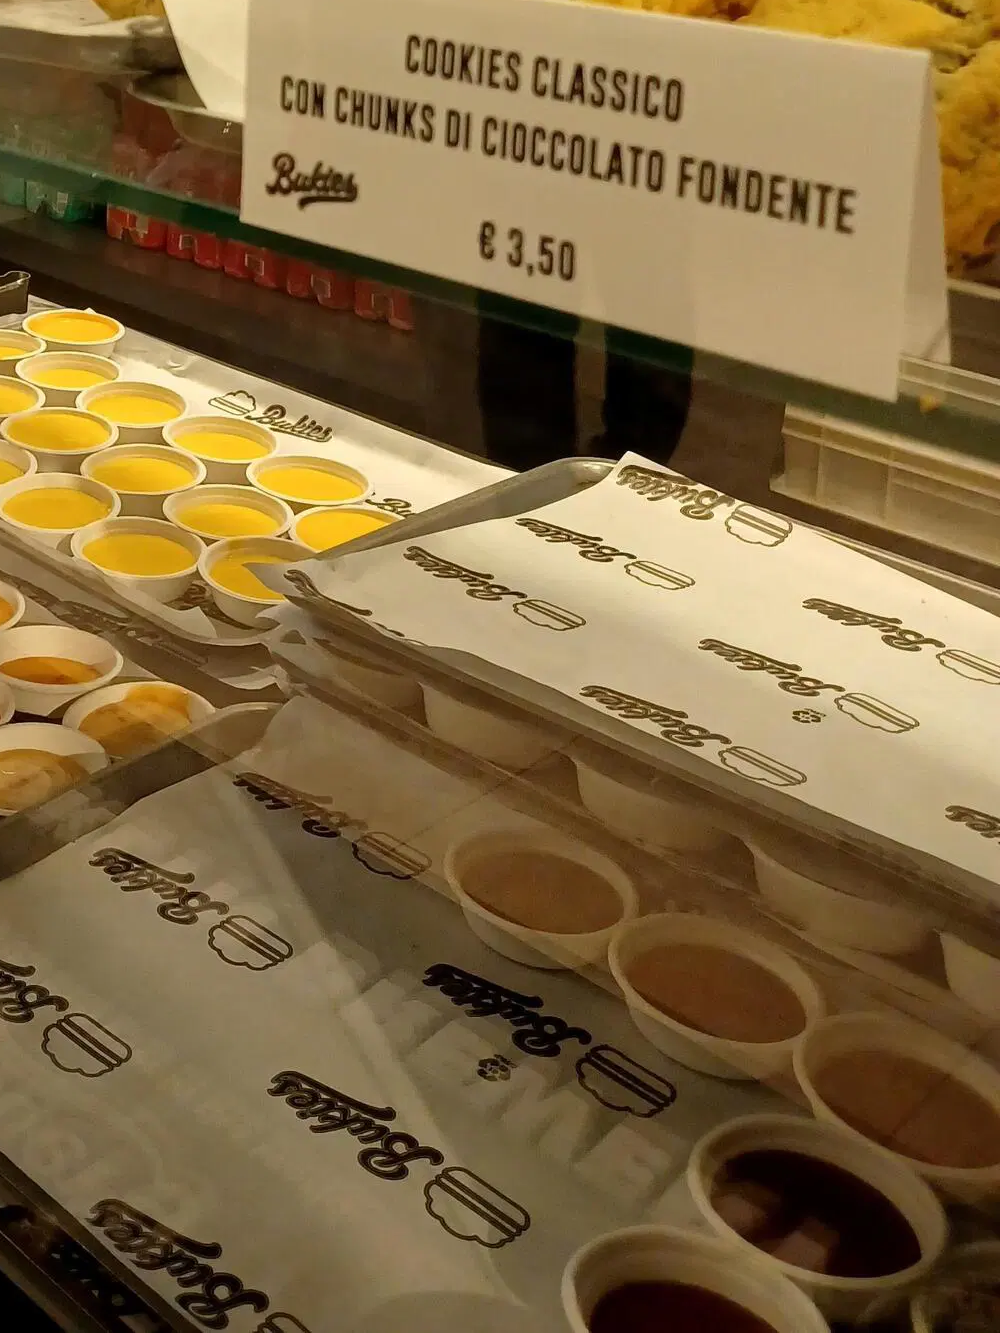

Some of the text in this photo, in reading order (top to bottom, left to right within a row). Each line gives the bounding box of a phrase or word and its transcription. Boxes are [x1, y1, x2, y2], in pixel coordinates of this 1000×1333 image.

[404, 33, 686, 123] COOKIES CLASSICO
[265, 151, 359, 210] Bukies
[280, 74, 858, 235] CON CHUNKS DI CIOCCOLATO FONDENTE
[478, 220, 577, 283] € 3,50
[244, 404, 333, 443] Bukies
[617, 464, 735, 521] Bukies
[515, 517, 638, 563] Bukies
[403, 545, 528, 602] Bukies
[801, 597, 946, 652] Bukies
[698, 638, 846, 697] Bukies
[579, 684, 732, 748] Bukies
[88, 847, 230, 926] Bukies
[422, 963, 593, 1058] Bukies
[269, 1070, 444, 1182] Bukies
[84, 1198, 269, 1331] Bukies
